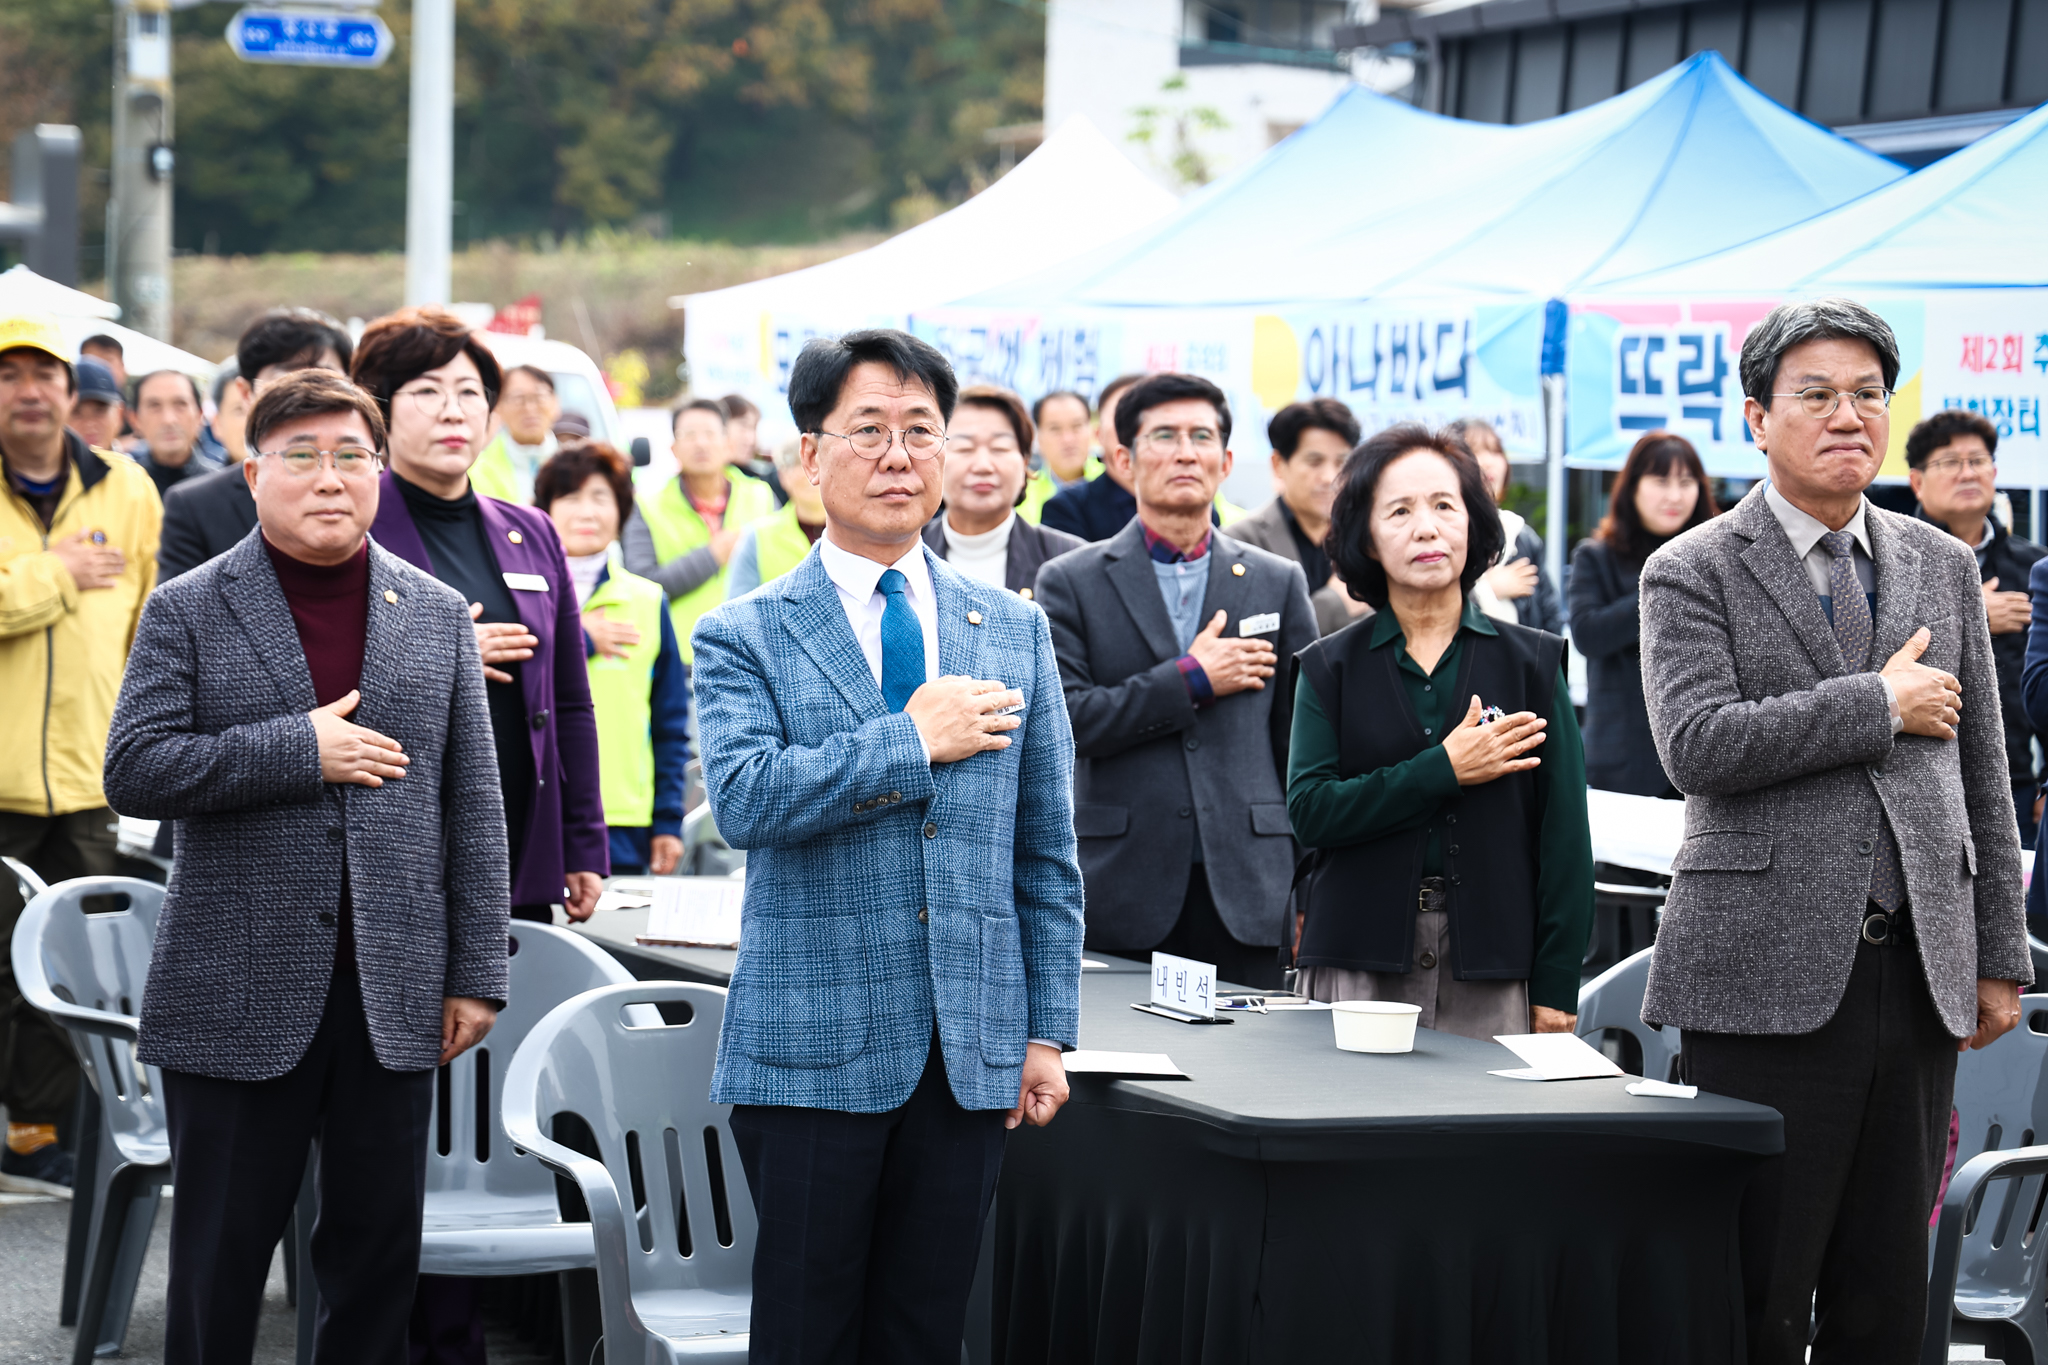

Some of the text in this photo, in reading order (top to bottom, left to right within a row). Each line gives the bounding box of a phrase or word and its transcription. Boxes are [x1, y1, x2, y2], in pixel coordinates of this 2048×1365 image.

[1305, 320, 1471, 400] 아나바다
[1960, 335, 2023, 373] 제2회
[1619, 333, 1754, 443] 뜨락
[1943, 398, 2040, 437] 장터
